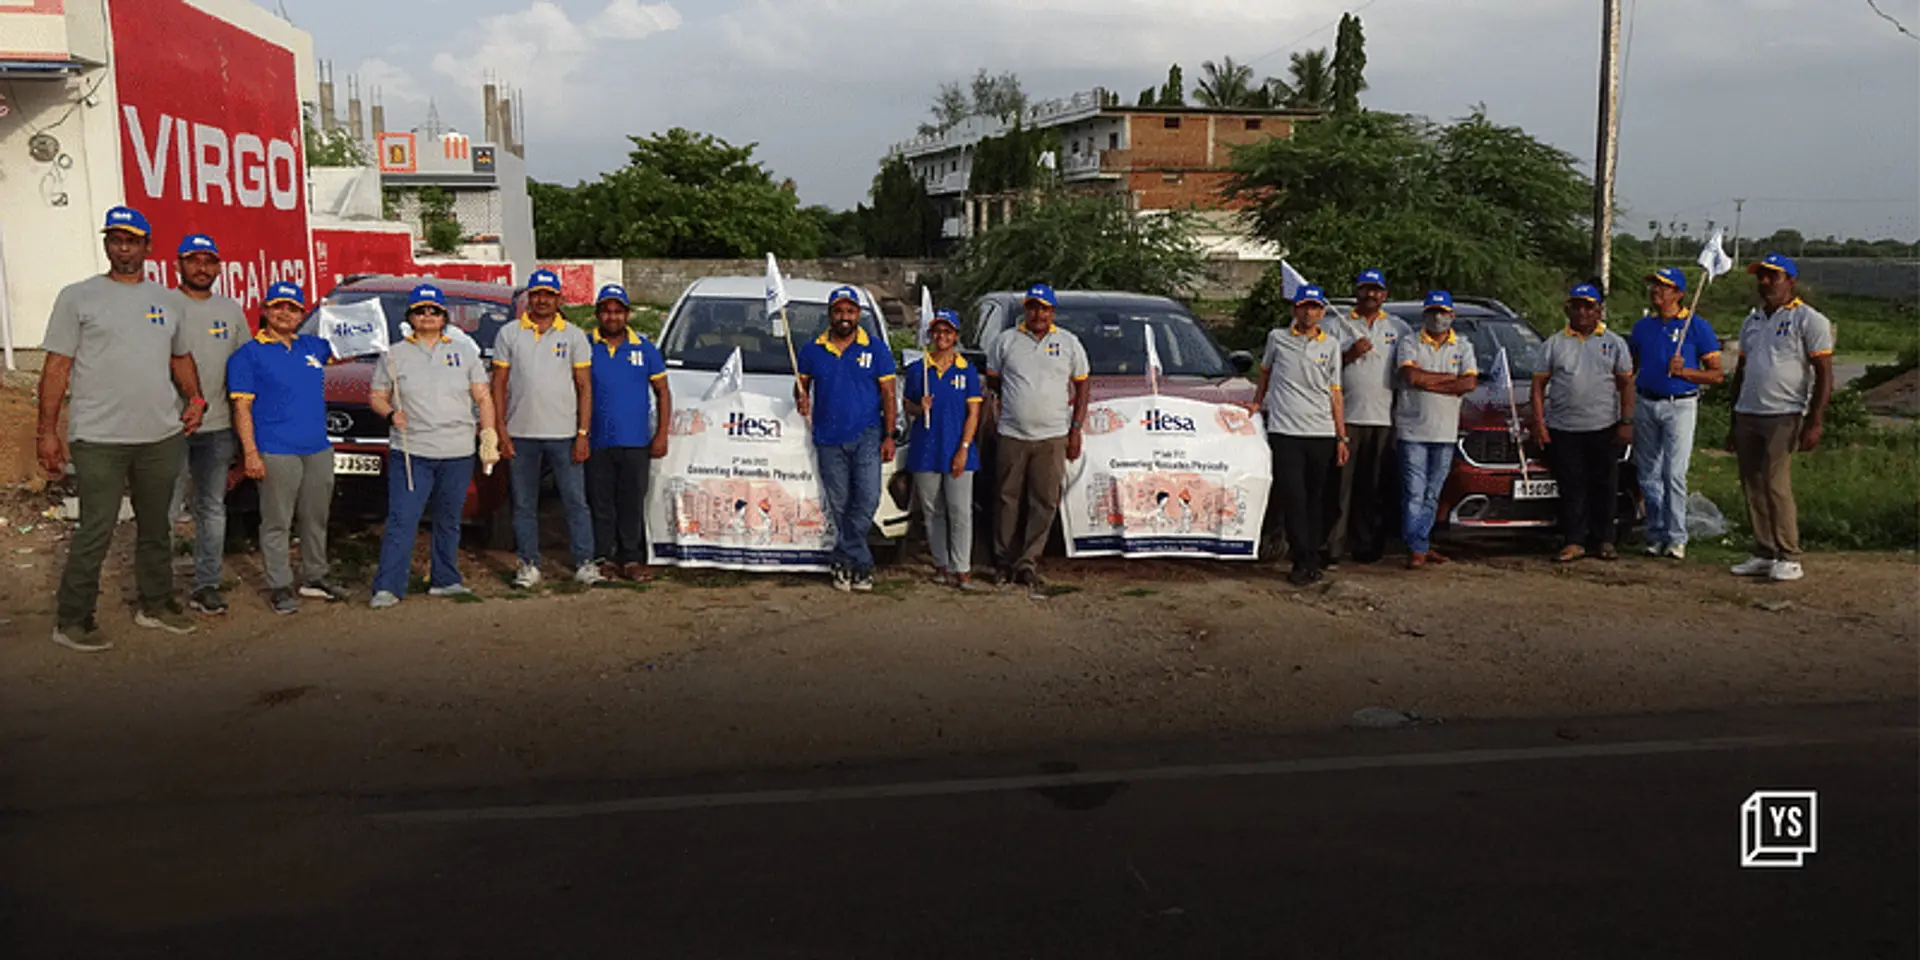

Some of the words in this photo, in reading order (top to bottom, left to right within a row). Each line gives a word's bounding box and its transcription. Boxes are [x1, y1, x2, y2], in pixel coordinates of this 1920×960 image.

[122, 105, 298, 209] VIRGO
[722, 412, 781, 437] Hesa
[1139, 409, 1196, 432] Hesa
